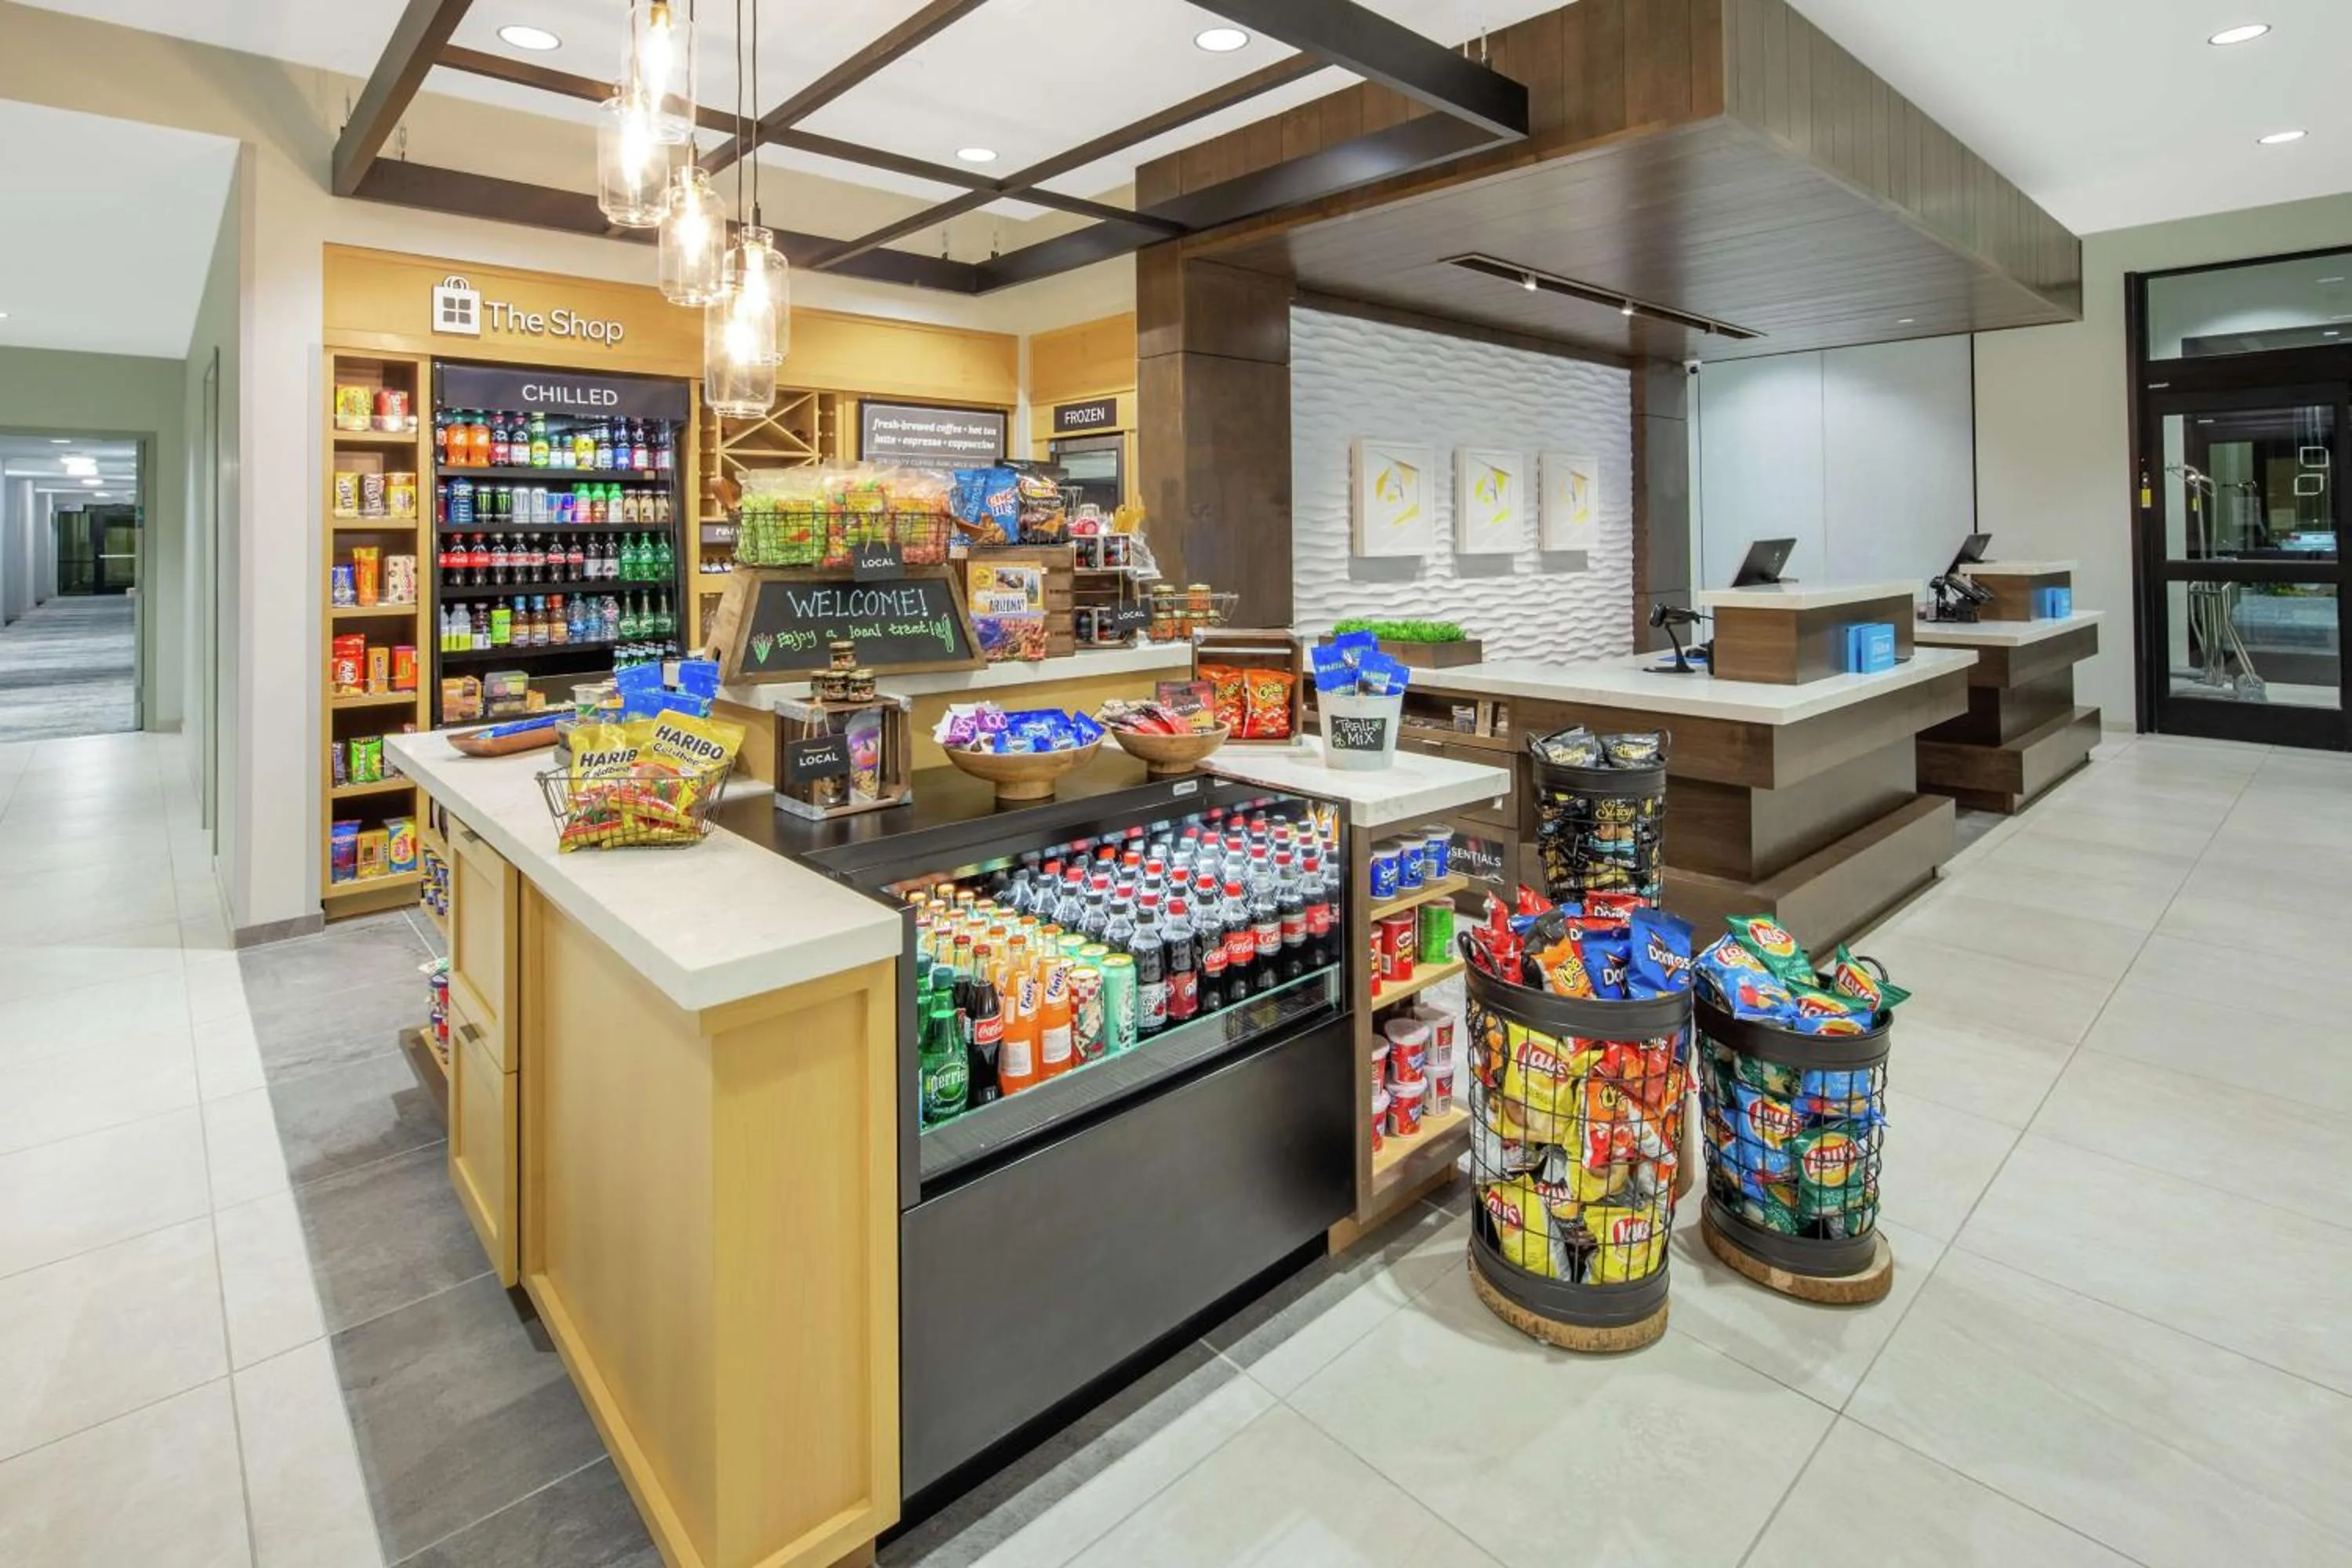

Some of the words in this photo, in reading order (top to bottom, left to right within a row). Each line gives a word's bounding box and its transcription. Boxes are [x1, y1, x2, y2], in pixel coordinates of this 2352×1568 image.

[483, 300, 545, 333] The
[550, 309, 624, 346] Shop
[521, 384, 619, 406] CHILLED
[1065, 407, 1105, 424] FROZEN
[862, 557, 895, 568] LOCAL
[787, 589, 929, 618] WELCOME!
[1117, 611, 1145, 620] LOCAL
[777, 630, 817, 652] Enjoy
[826, 630, 837, 638] a
[849, 624, 882, 639] local
[655, 724, 726, 760] HARIBO
[579, 749, 638, 768] HARIB
[799, 752, 840, 766] LOCAL
[1451, 847, 1502, 867] SENTIALS
